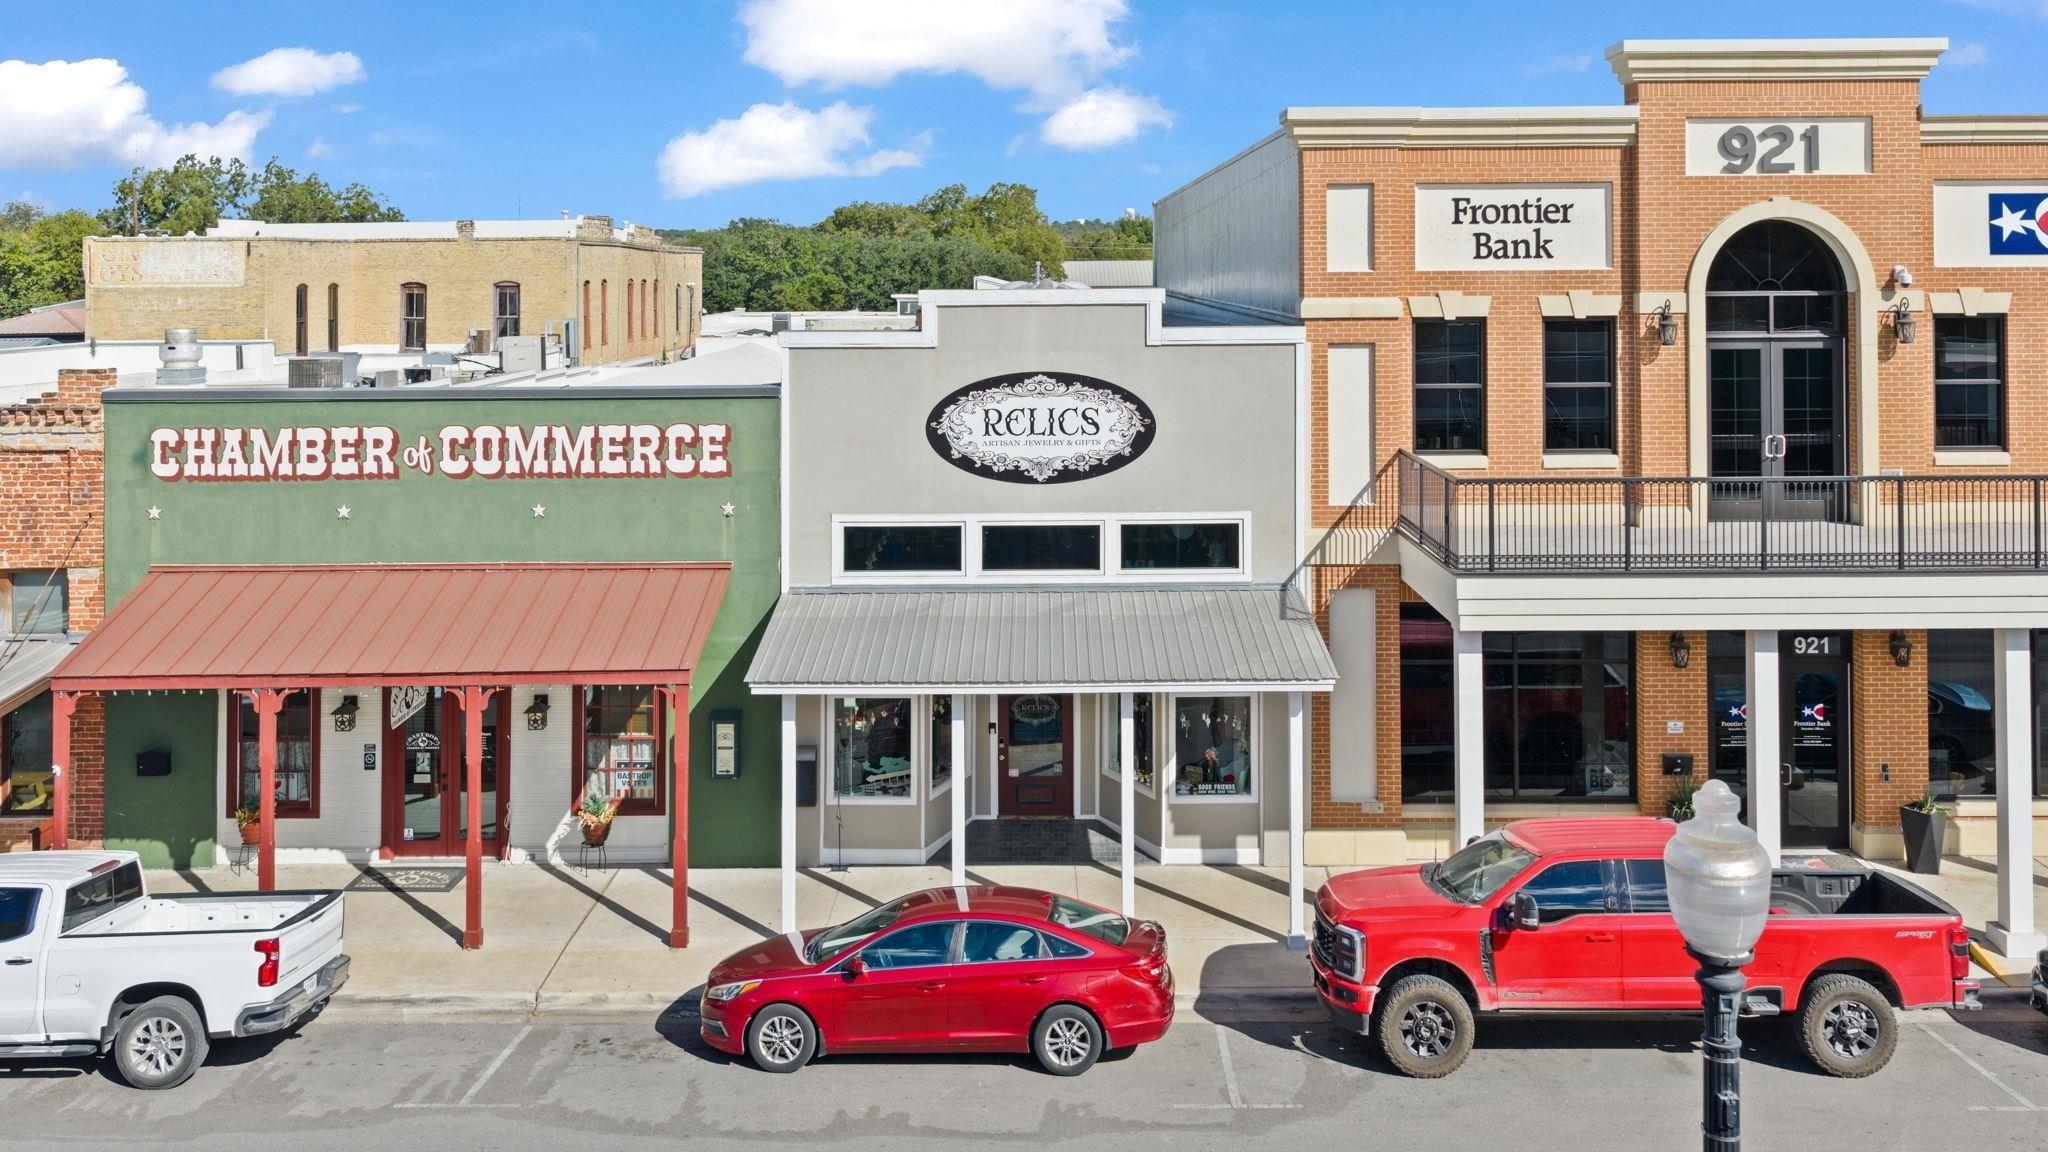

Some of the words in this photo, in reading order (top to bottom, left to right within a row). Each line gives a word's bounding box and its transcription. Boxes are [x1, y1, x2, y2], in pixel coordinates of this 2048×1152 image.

[1717, 125, 1819, 174] 921
[1451, 197, 1575, 225] Frontier
[1472, 227, 1554, 260] Bank
[982, 407, 1101, 437] RELICS
[150, 426, 400, 482] CHAMBER
[403, 435, 434, 475] of
[439, 424, 732, 480] COMMERCE
[982, 439, 1021, 447] ARTISAN
[1023, 439, 1065, 447] JEWELRY
[1066, 439, 1073, 447] &
[1074, 439, 1101, 447] GIFTS
[1794, 636, 1829, 654] 921
[617, 772, 652, 780] BASTROP
